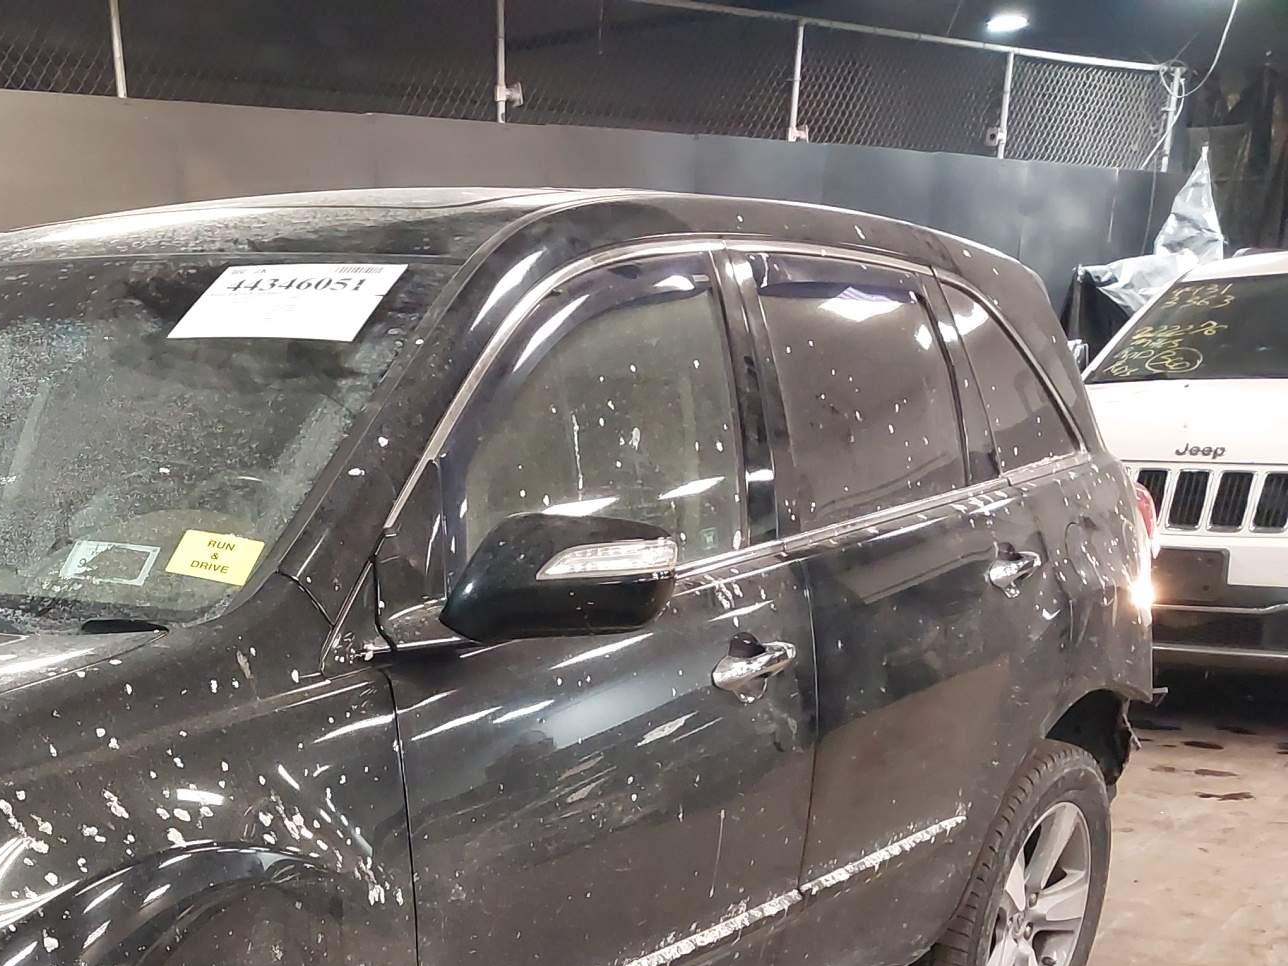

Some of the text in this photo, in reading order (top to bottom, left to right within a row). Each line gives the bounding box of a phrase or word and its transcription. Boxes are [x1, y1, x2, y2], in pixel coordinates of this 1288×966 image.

[226, 277, 367, 292] 44346051
[1175, 443, 1226, 459] Jeep
[208, 540, 235, 551] RUN
[210, 552, 218, 560] &
[190, 560, 230, 574] DRIVE
